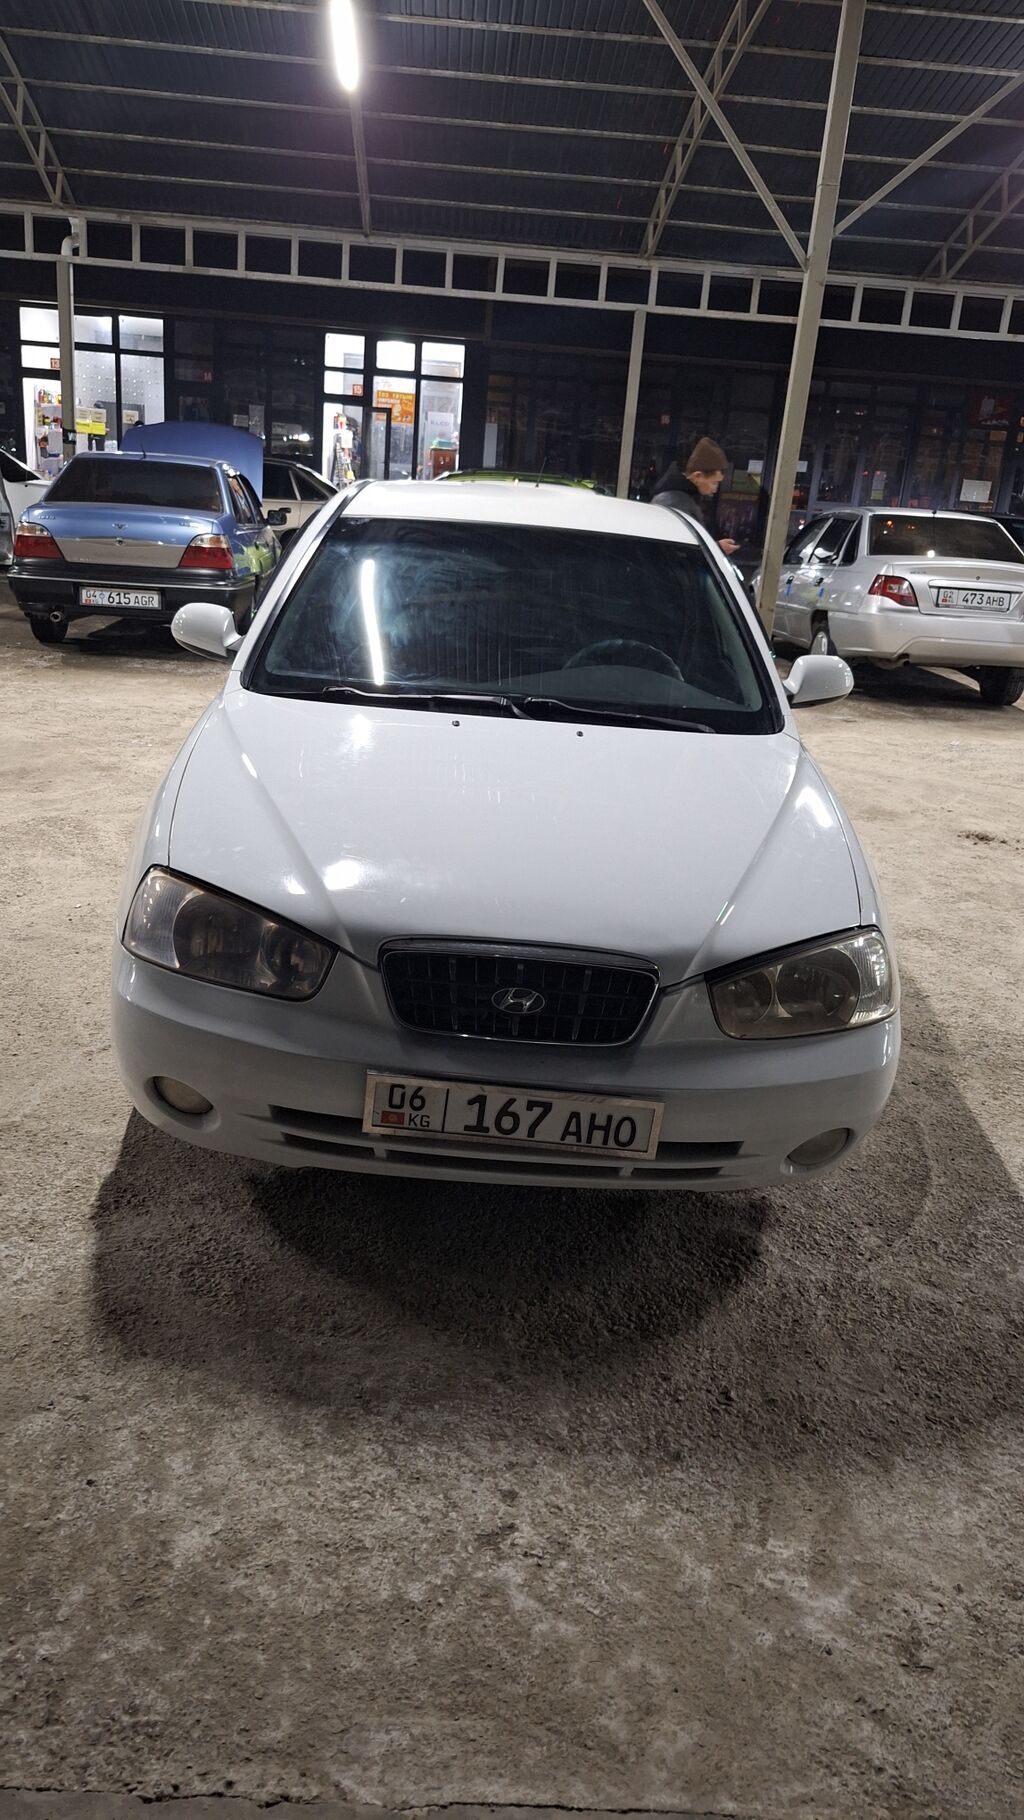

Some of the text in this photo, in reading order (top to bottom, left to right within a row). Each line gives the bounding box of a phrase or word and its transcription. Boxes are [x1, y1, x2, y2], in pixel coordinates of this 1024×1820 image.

[107, 591, 131, 605] 615
[133, 595, 155, 606] AGR
[962, 592, 985, 605] 473
[985, 596, 1005, 607] AHB
[388, 1083, 637, 1148] 06 167 AHO
[408, 1112, 430, 1128] KG
